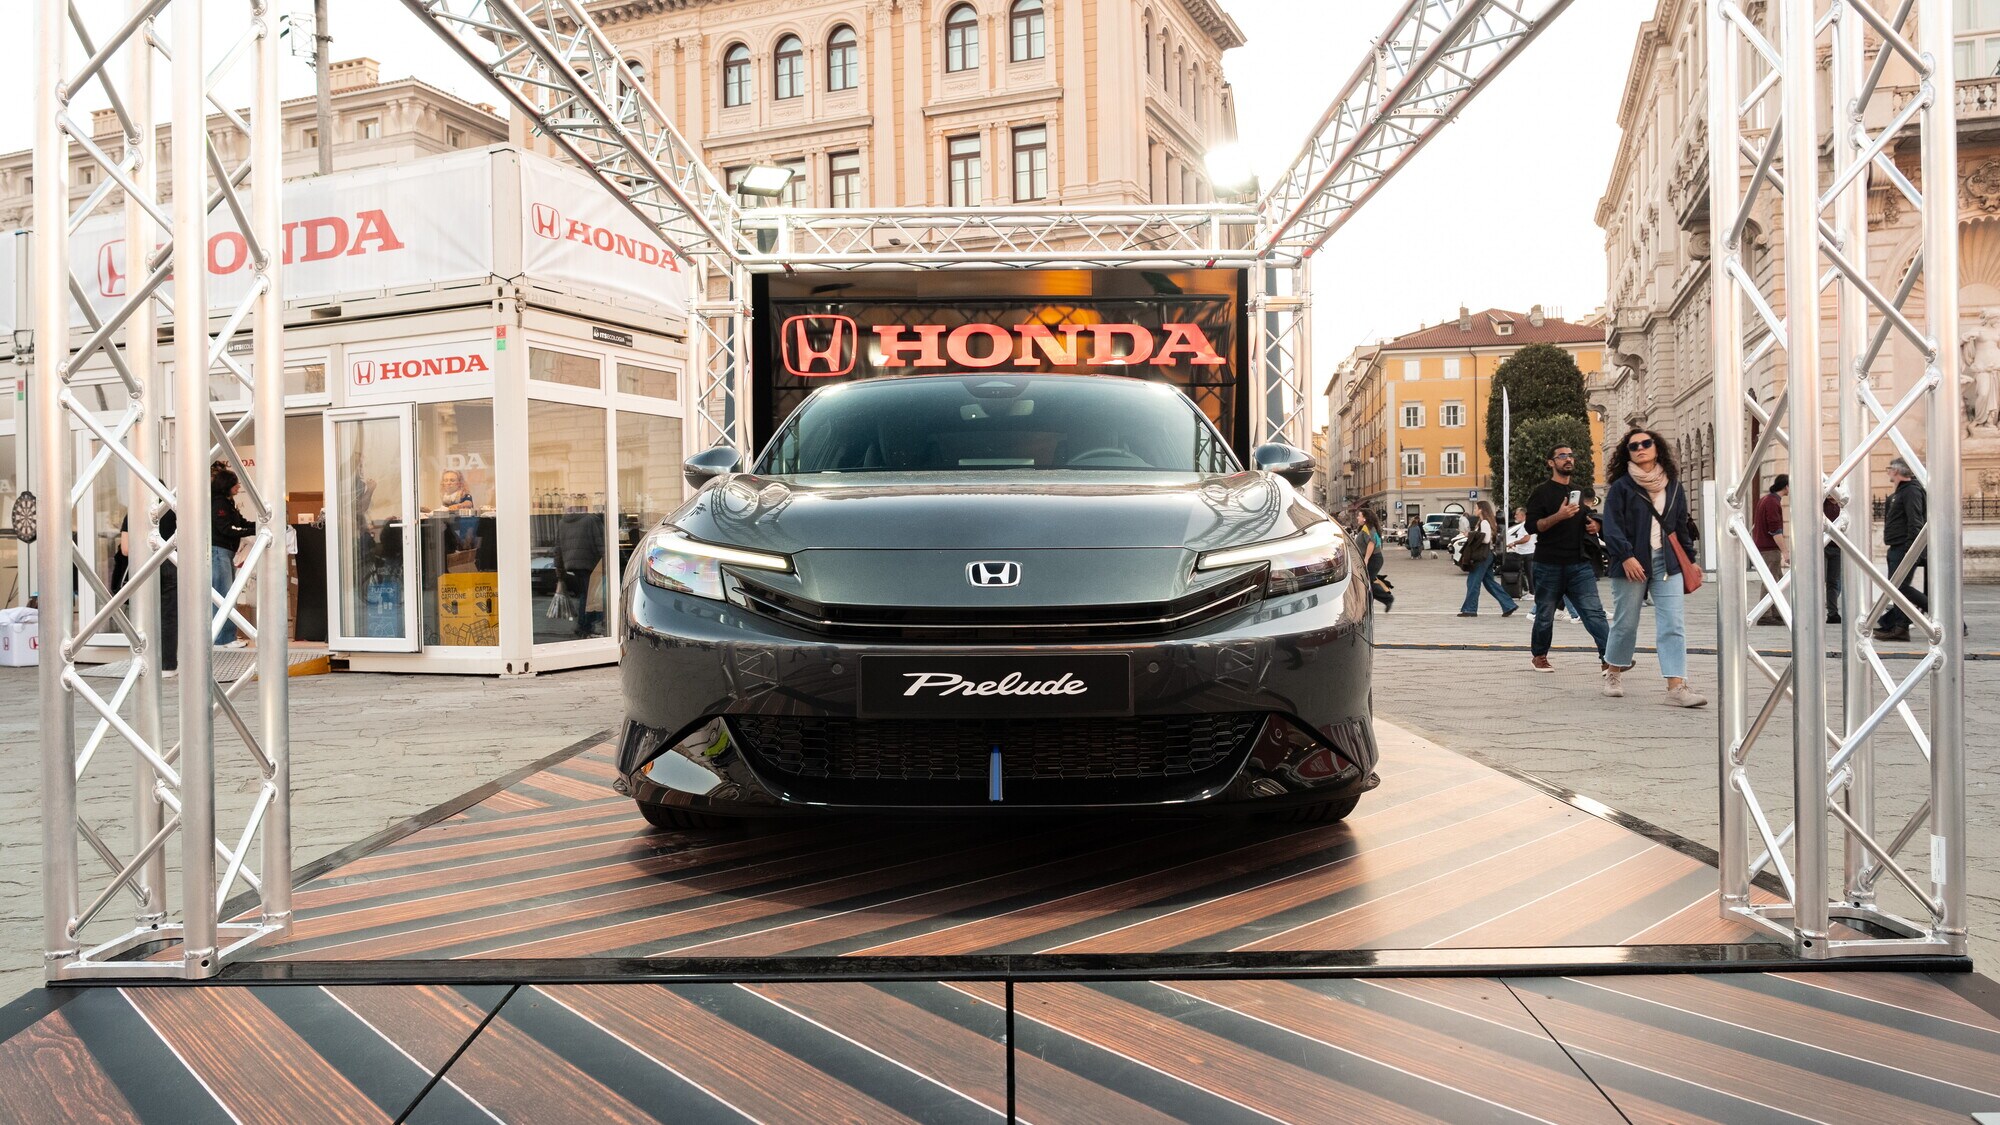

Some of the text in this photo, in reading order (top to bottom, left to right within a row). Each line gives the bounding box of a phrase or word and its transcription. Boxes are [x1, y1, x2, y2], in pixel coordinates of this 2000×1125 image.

[565, 218, 681, 273] HONDA
[872, 323, 1227, 367] HONDA
[379, 354, 490, 380] HONDA
[902, 671, 1088, 697] Prelude
